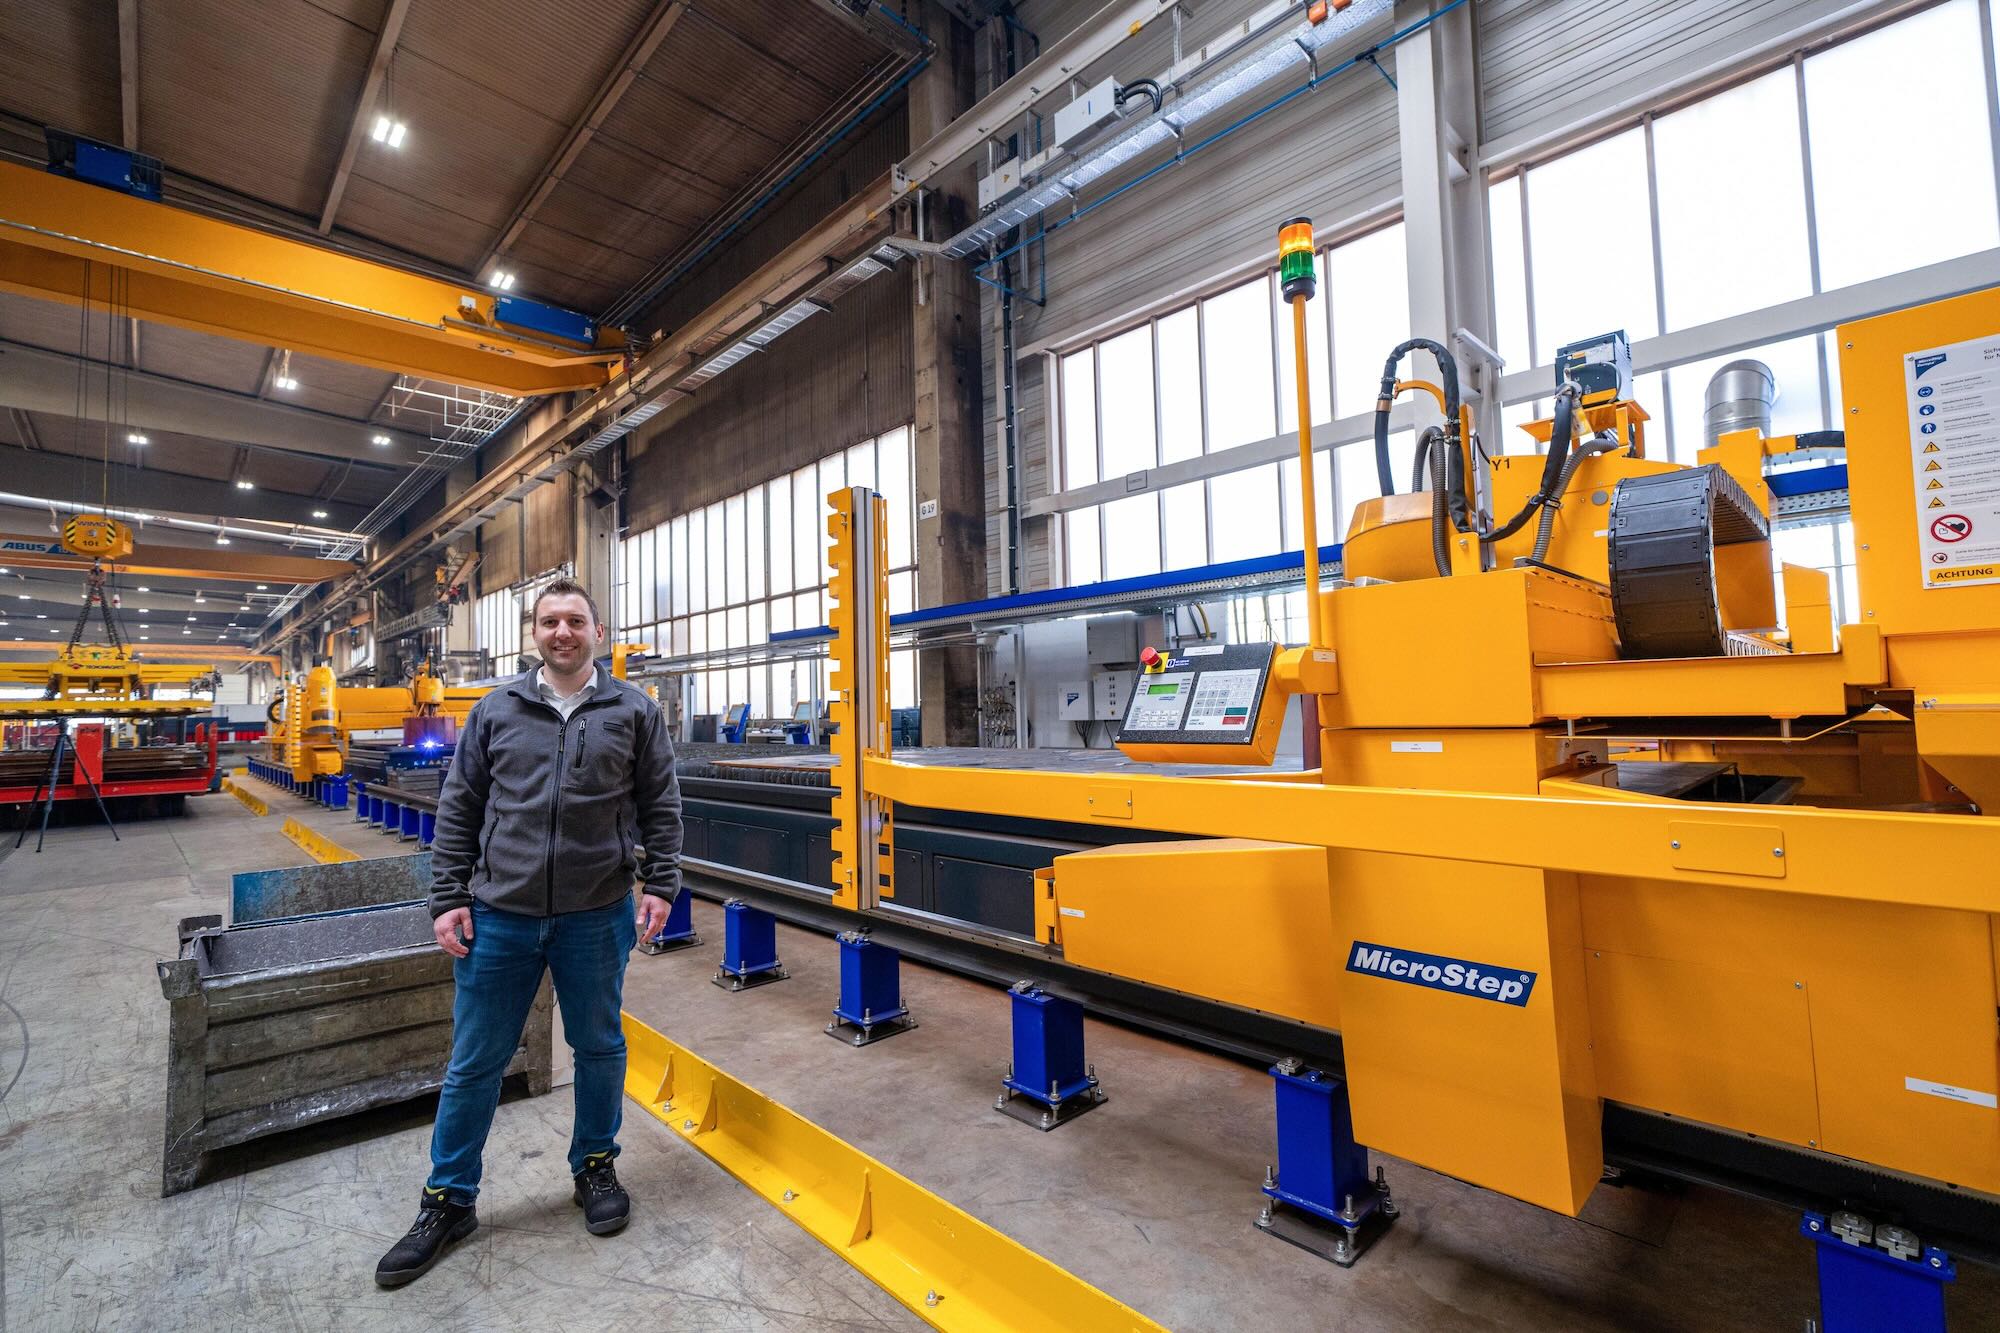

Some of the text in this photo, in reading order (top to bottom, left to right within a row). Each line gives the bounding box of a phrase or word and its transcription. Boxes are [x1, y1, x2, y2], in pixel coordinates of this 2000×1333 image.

[1492, 458, 1510, 471] Y1
[1, 542, 46, 552] ABUS
[1936, 567, 1993, 579] ACHTUNG
